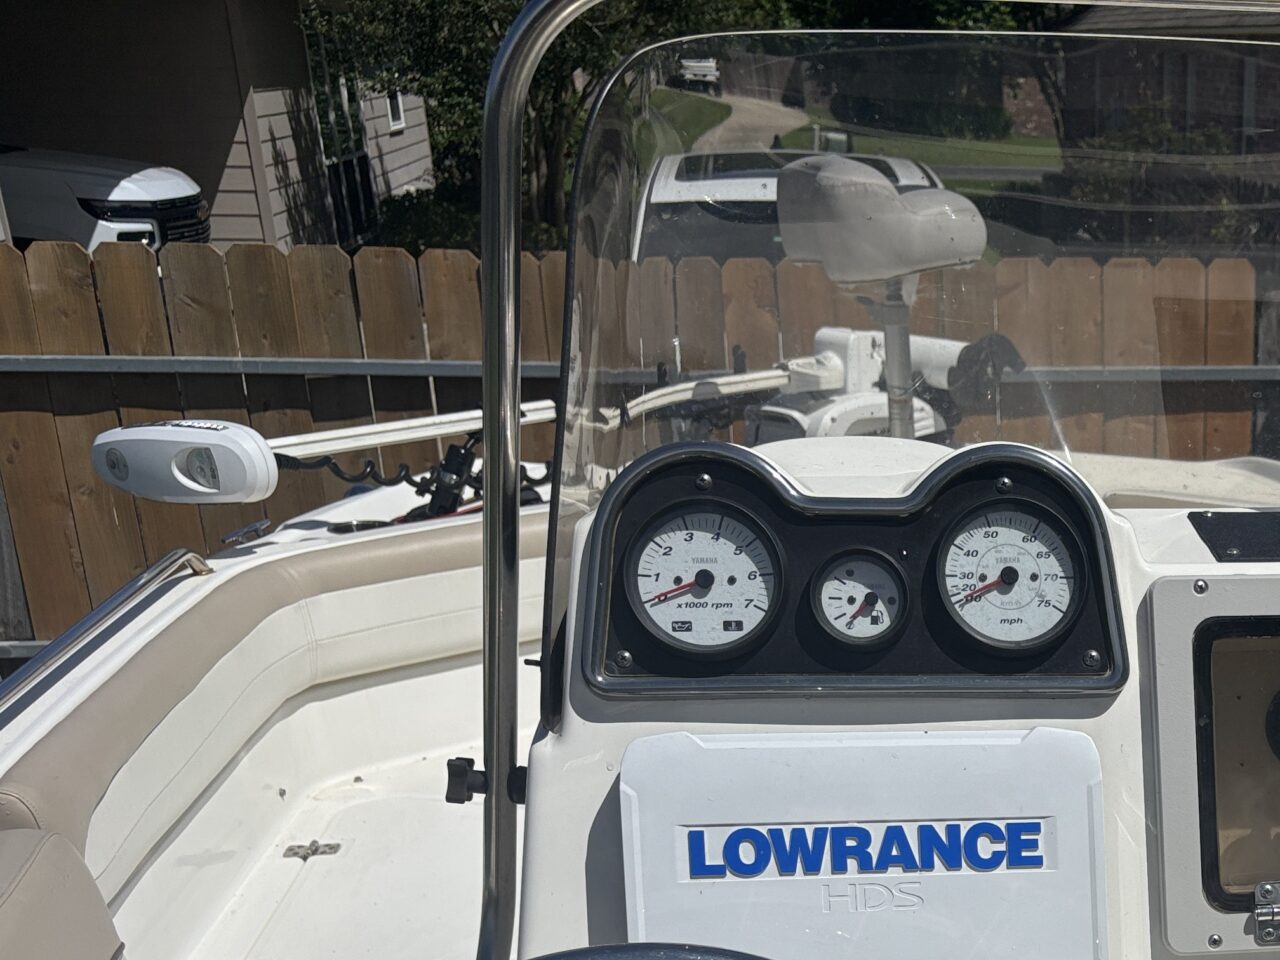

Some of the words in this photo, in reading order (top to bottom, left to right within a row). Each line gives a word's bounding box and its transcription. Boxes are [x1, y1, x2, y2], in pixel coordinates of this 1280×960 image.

[684, 532, 694, 542] 3
[711, 532, 721, 542] 4
[983, 530, 999, 539] 50
[1021, 535, 1037, 543] 60
[662, 546, 673, 556] 2
[733, 545, 744, 556] 5
[963, 549, 979, 558] 40
[1036, 551, 1051, 559] 65
[653, 572, 661, 582] 1
[747, 571, 758, 581] 6
[958, 572, 975, 580] 30
[960, 583, 977, 592] 20
[676, 601, 709, 609] x1000
[711, 602, 733, 610] rpm
[744, 598, 755, 609] 7
[1037, 600, 1052, 608] 75
[1000, 617, 1023, 626] mph
[687, 821, 1045, 880] LOWRANCE
[821, 881, 926, 914] HDS
